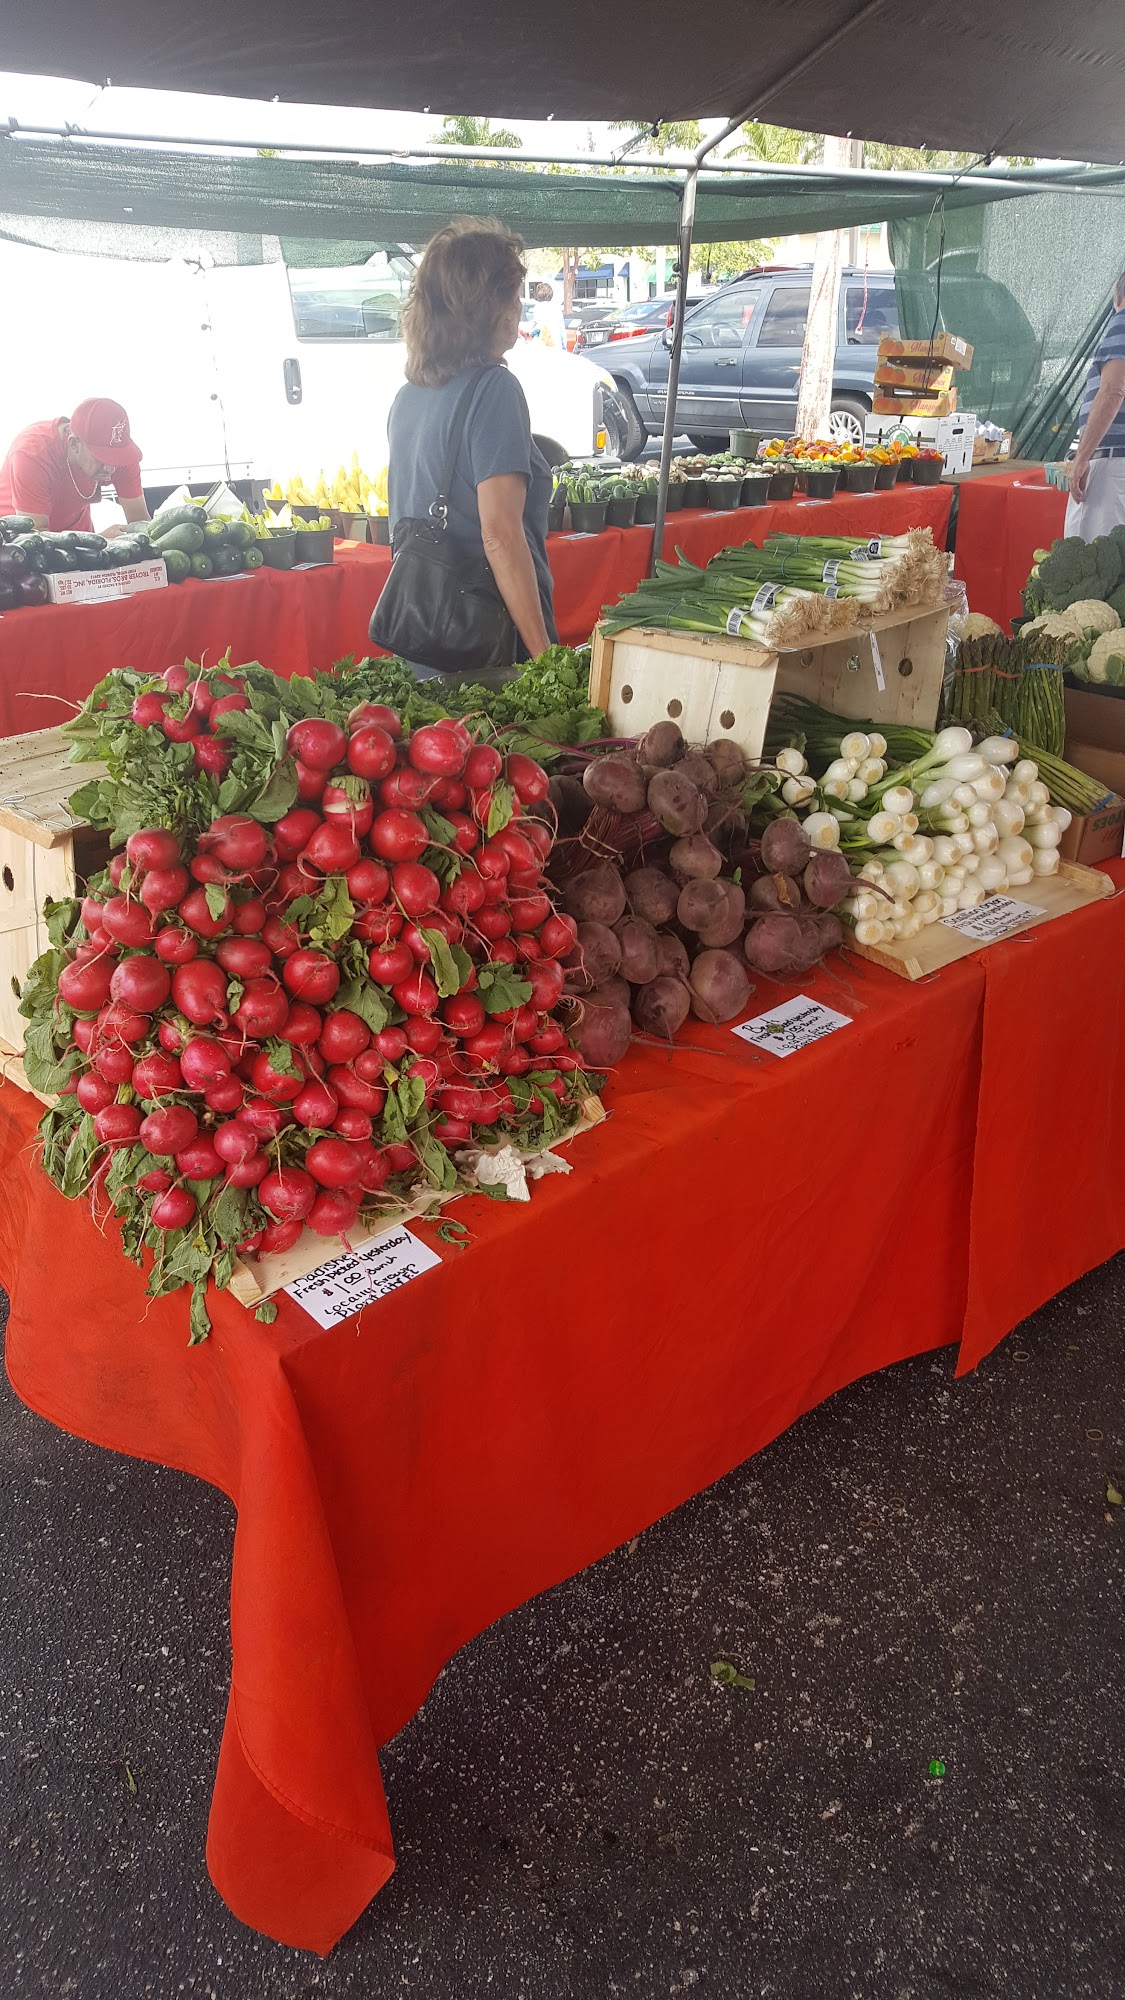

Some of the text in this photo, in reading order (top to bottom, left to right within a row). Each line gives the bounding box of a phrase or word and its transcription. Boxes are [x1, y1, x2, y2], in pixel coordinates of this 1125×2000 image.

[911, 342, 940, 354] Manges
[293, 1275, 329, 1299] Fresh
[325, 1259, 360, 1281] Picked
[374, 1263, 416, 1287] Grown
